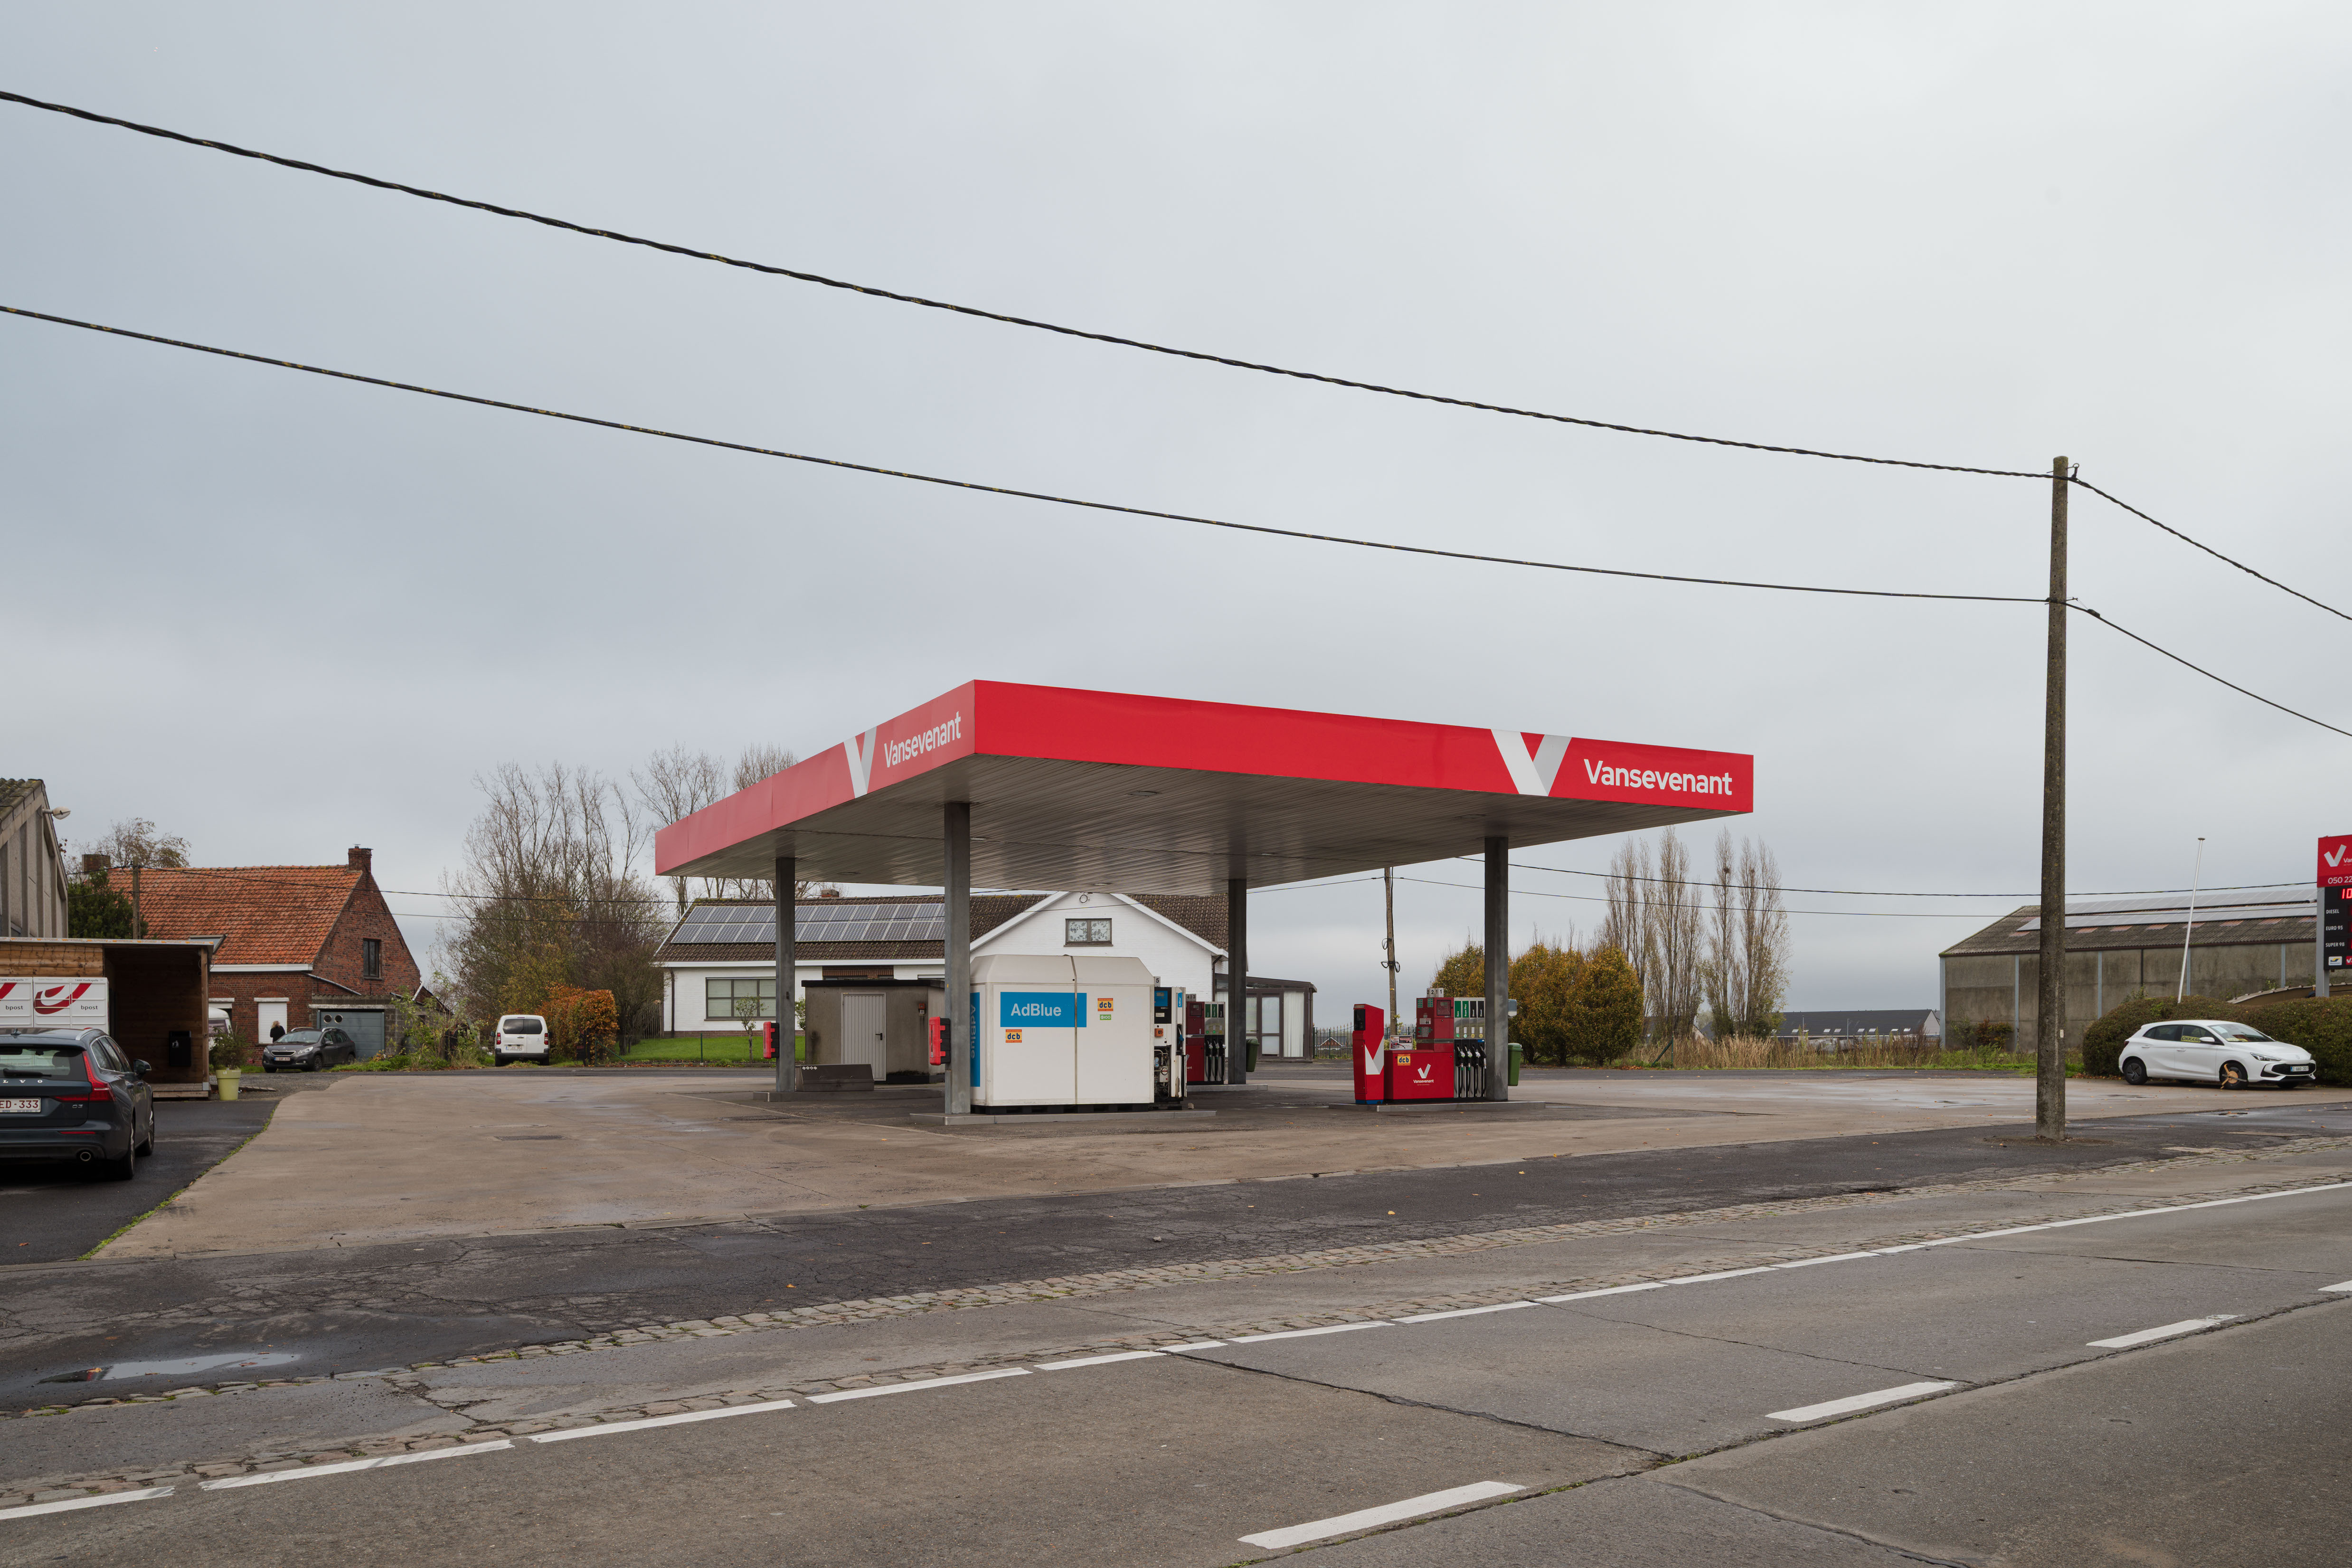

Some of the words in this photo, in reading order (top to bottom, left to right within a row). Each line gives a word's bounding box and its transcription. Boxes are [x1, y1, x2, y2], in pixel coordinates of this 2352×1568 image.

[884, 710, 961, 768] Vansevenant
[1584, 758, 1732, 795] Vansevenant
[1011, 1003, 1062, 1017] AdBlue
